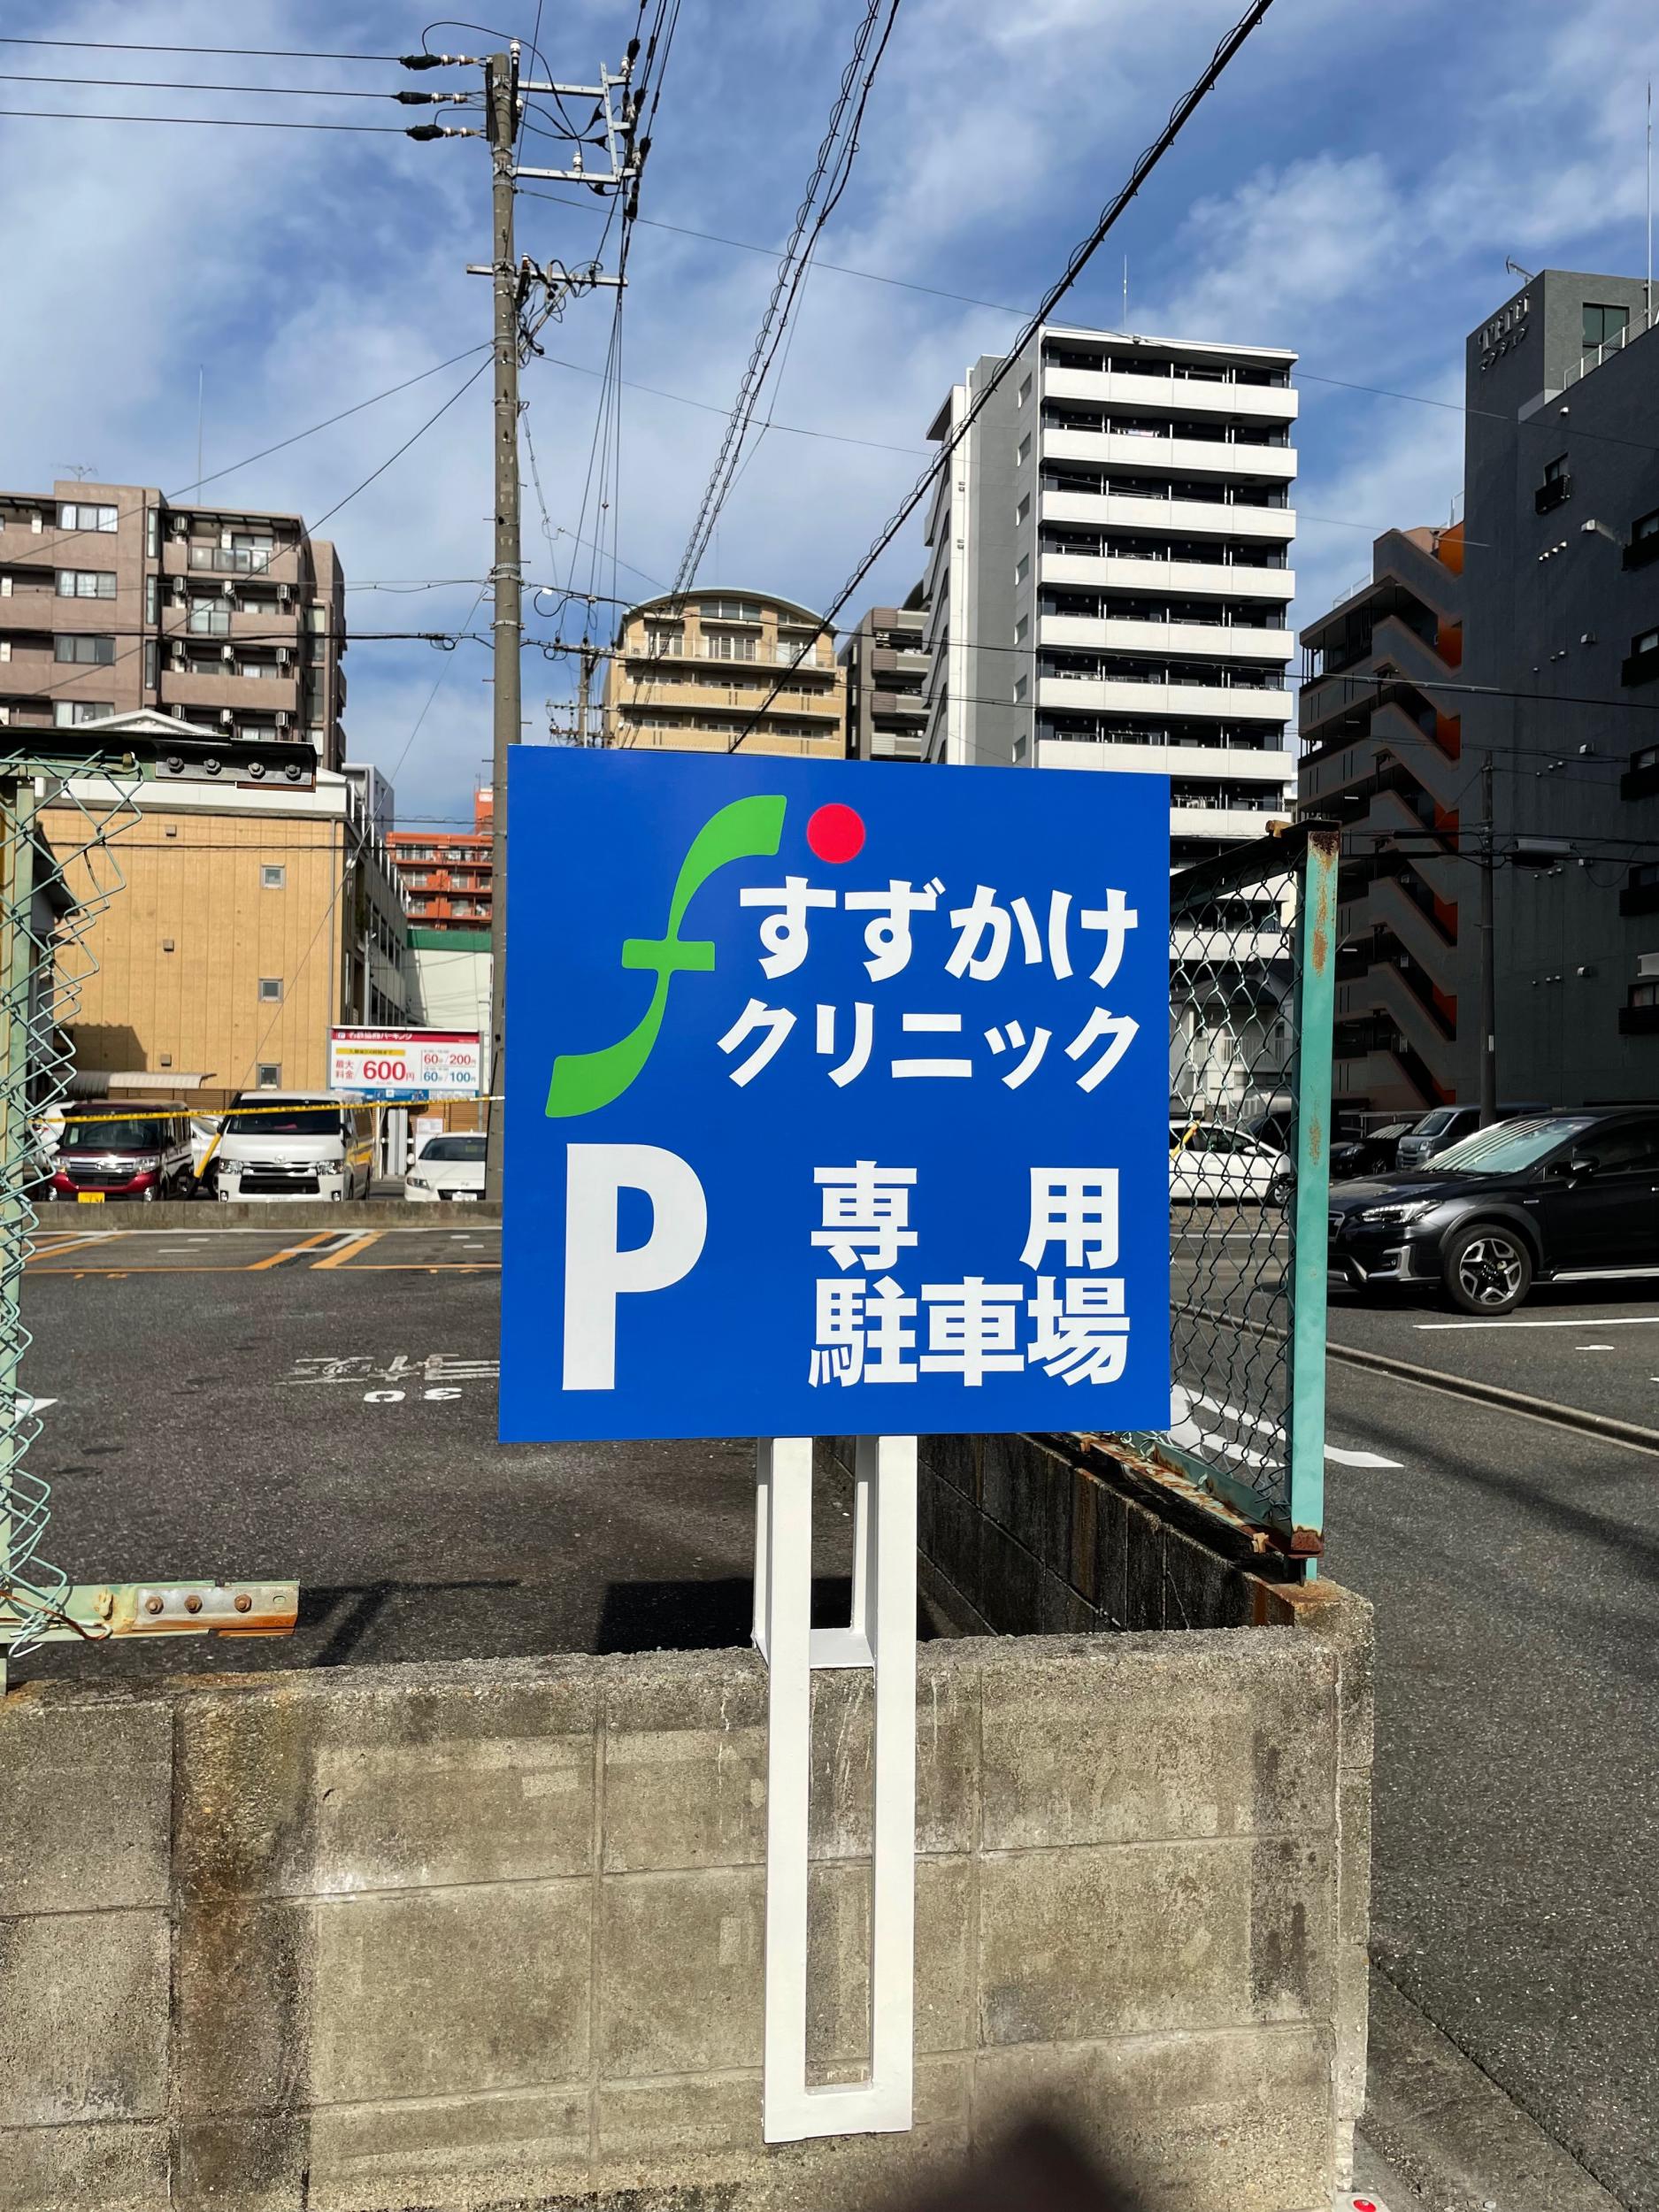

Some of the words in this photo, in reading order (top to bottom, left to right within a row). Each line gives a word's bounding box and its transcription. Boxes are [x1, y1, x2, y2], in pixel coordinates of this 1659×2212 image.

[739, 875, 1139, 989] すずかけ
[717, 997, 1141, 1094] クリニック
[562, 1143, 708, 1391] P
[810, 1160, 1120, 1271] 専用
[808, 1275, 1131, 1388] 駐車場
